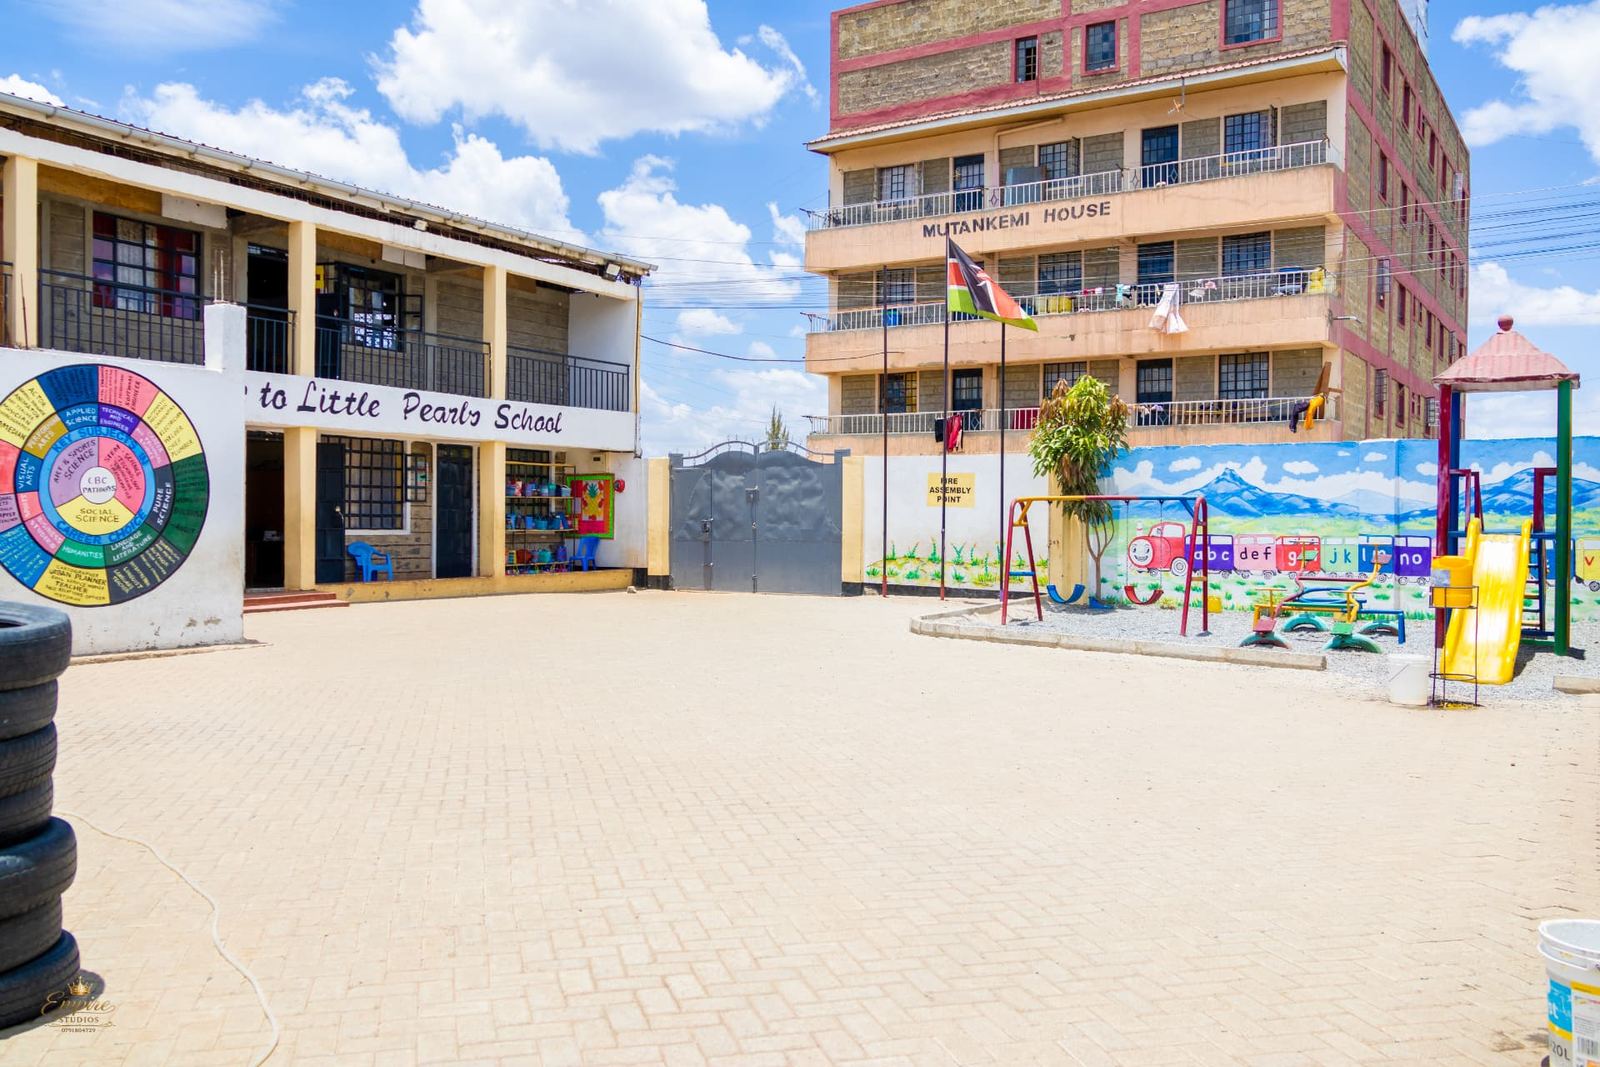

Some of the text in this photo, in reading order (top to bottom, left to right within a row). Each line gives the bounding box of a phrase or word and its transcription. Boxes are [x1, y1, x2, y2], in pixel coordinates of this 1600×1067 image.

[923, 201, 1111, 238] MUTANKEMI HOUSE
[131, 381, 141, 411] ENGINEER
[66, 407, 96, 417] APPLIED
[102, 407, 133, 423] TECHNICAL
[259, 380, 563, 434] to Little Pearls School
[0, 420, 26, 440] MEDIAN
[66, 415, 97, 426] SCIENCE
[53, 433, 71, 452] KEY
[104, 444, 121, 461] STEM
[54, 468, 63, 484] ART
[68, 440, 97, 457] SPORTS
[64, 449, 95, 480] SCIENCE
[18, 458, 29, 489] VISUAL
[26, 466, 35, 486] ARTS
[153, 488, 164, 513] PURE
[157, 482, 172, 526] SCIENCE
[57, 509, 146, 544] CAREER CHOICE
[76, 515, 119, 523] SCIENCE
[111, 530, 142, 551] LANGUAGE
[113, 535, 152, 561] LITERATURE
[62, 546, 104, 559] HUMANITIES
[56, 580, 87, 593] TEACHER
[74, 573, 107, 585] PLANNER
[1552, 1041, 1571, 1062] 20L
